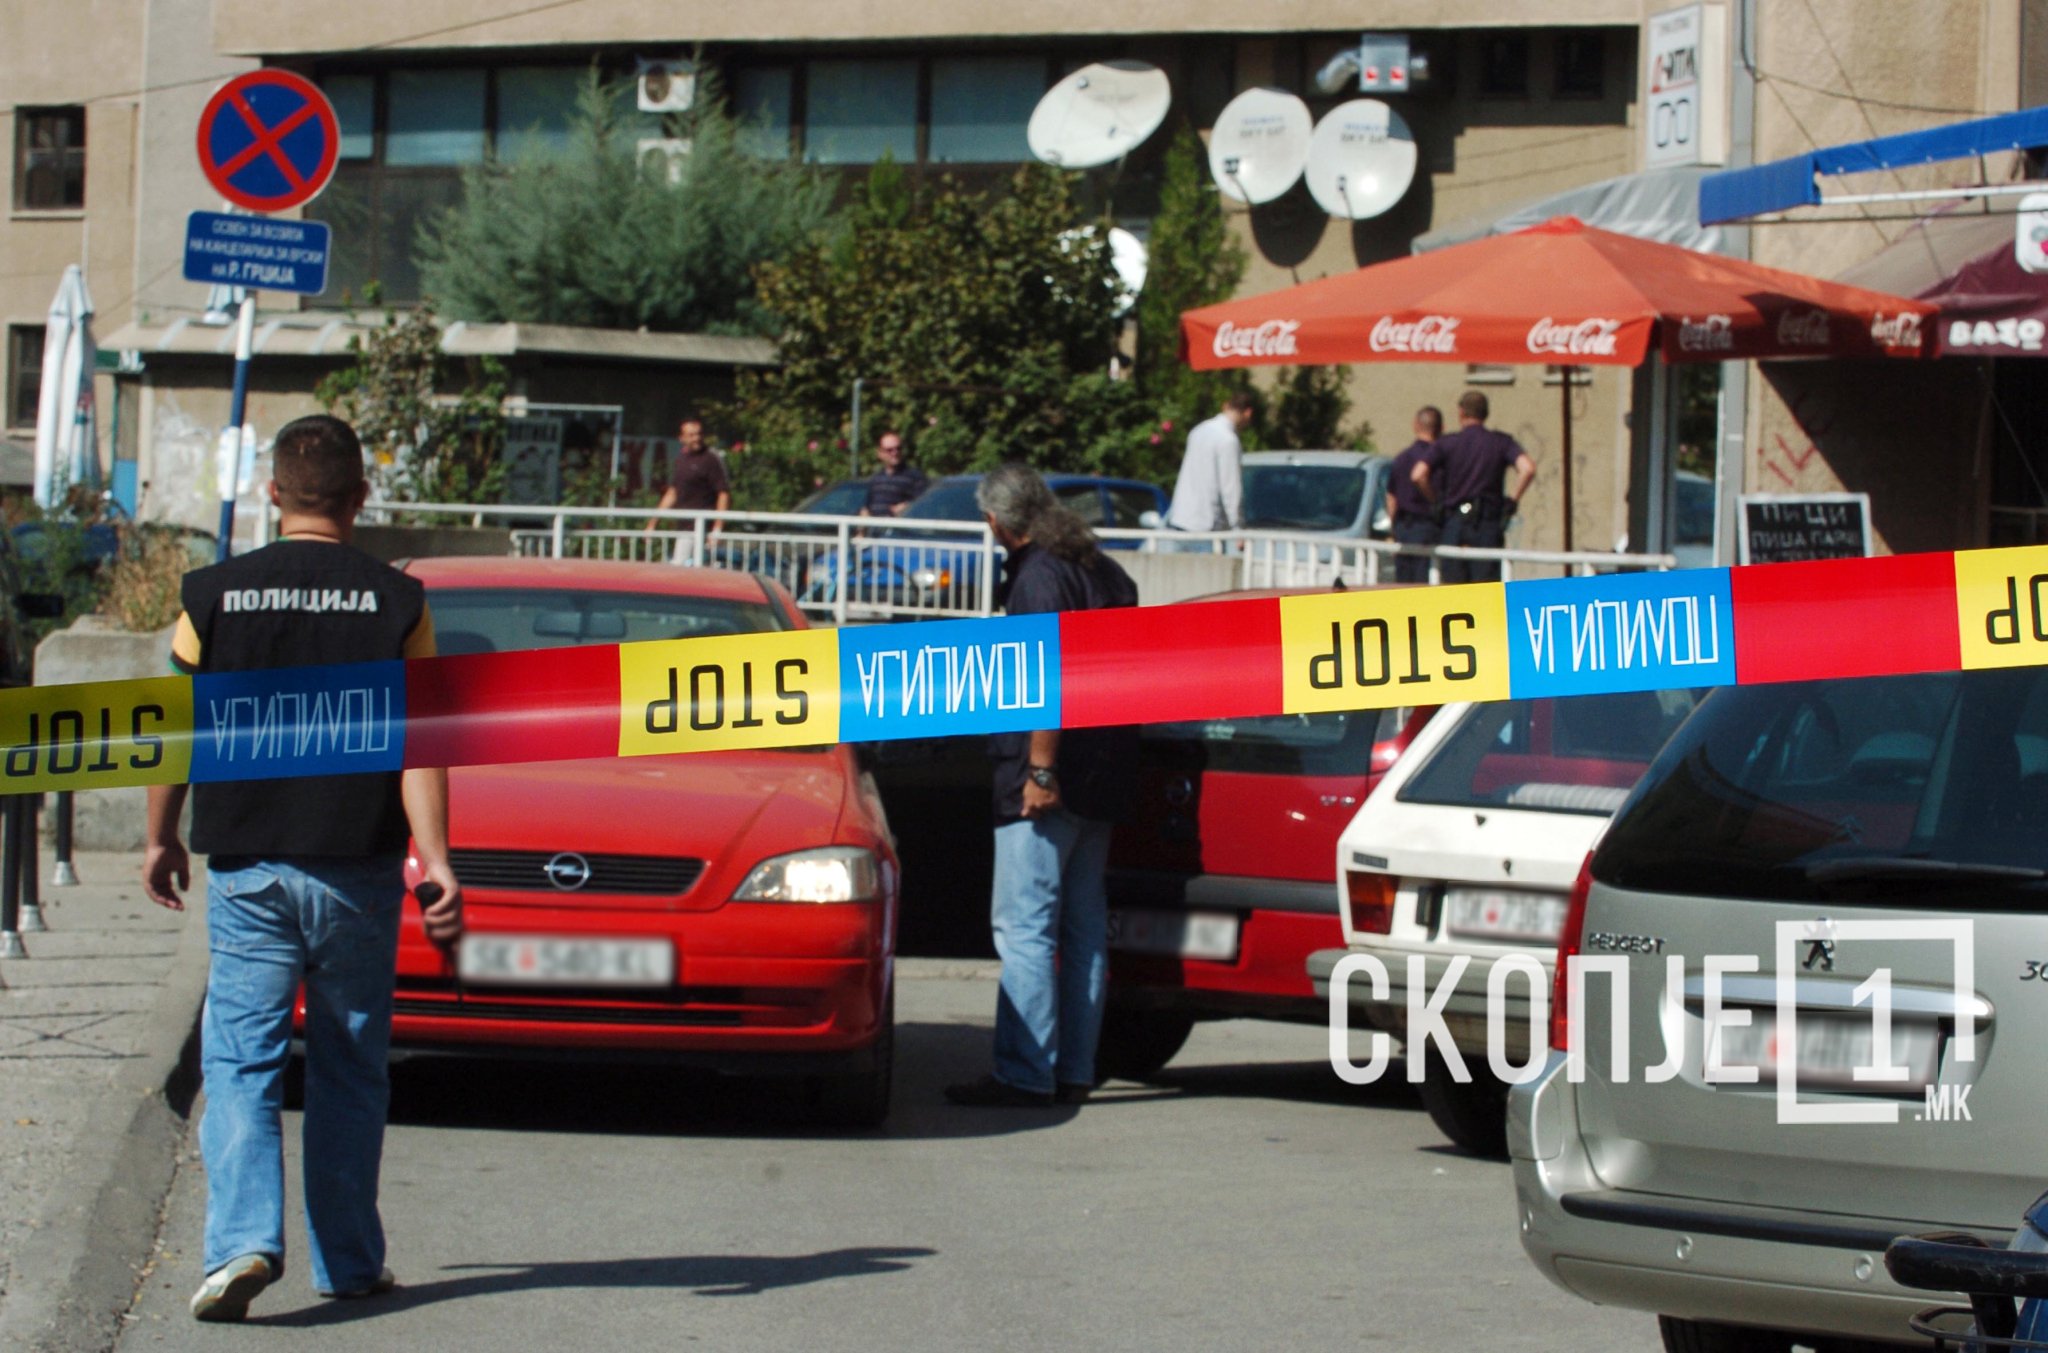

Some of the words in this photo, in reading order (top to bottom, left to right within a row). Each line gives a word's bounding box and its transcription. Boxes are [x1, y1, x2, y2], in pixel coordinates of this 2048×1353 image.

[242, 263, 295, 285] ГРЦИЈА
[223, 588, 377, 613] ПОЛИЦИЈА
[1524, 594, 1719, 674] ПОЛИЦИЈА
[856, 640, 1045, 719] ПОЛИЦИЈА
[1309, 612, 1476, 689] STOP
[210, 687, 390, 762] ПОЛИЦИЈА
[645, 658, 808, 734] STOP
[5, 703, 164, 777] STOP
[1588, 932, 1666, 954] PEUGEOT
